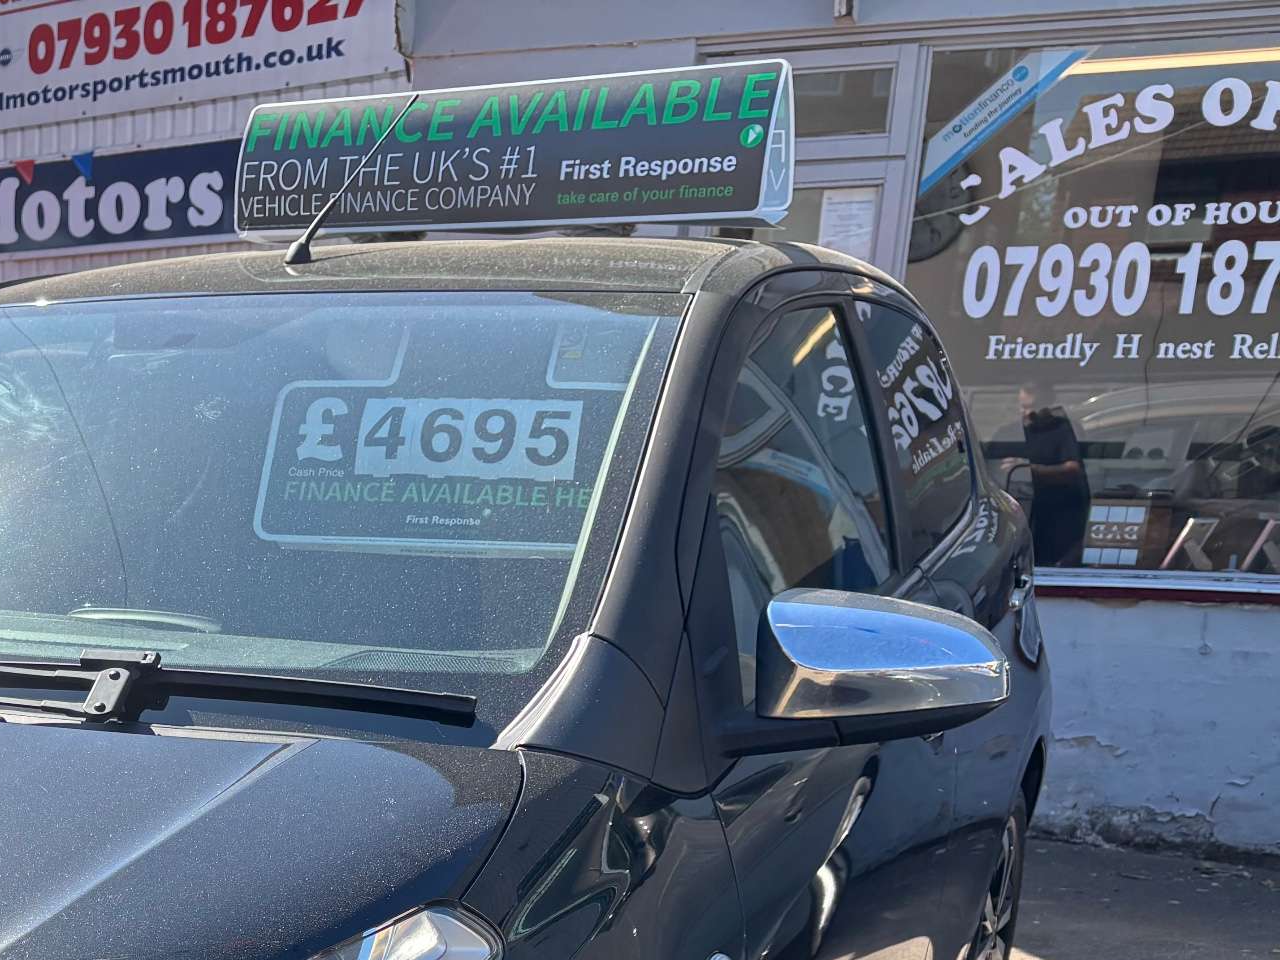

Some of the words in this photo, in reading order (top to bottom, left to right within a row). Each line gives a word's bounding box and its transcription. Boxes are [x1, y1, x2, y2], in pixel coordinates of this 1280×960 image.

[28, 2, 174, 75] 07930
[247, 99, 462, 152] FINANCE
[467, 72, 777, 139] AVAILABLE
[241, 157, 328, 192] FROM
[339, 153, 403, 187] THE
[413, 147, 490, 184] UK'S
[500, 145, 538, 179] #1
[559, 160, 611, 181] First
[619, 155, 737, 182] Response
[241, 193, 322, 218] VEHICLE
[329, 189, 419, 215] FINANCE
[425, 183, 536, 210] COMPANY
[557, 190, 588, 205] take
[589, 189, 619, 204] care
[623, 186, 638, 201] of
[641, 188, 674, 204] your
[679, 183, 734, 199] finance
[1063, 204, 1138, 229] OUT
[1147, 203, 1196, 226] OF
[962, 241, 1151, 318] 07930
[1176, 239, 1280, 316] 187
[985, 332, 1100, 367] Friendly
[288, 466, 315, 478] Cash
[318, 467, 345, 478] Price
[283, 481, 395, 502] FINANCE
[401, 481, 548, 507] AVAILABLE
[405, 514, 429, 524] First
[431, 515, 481, 526] Response
